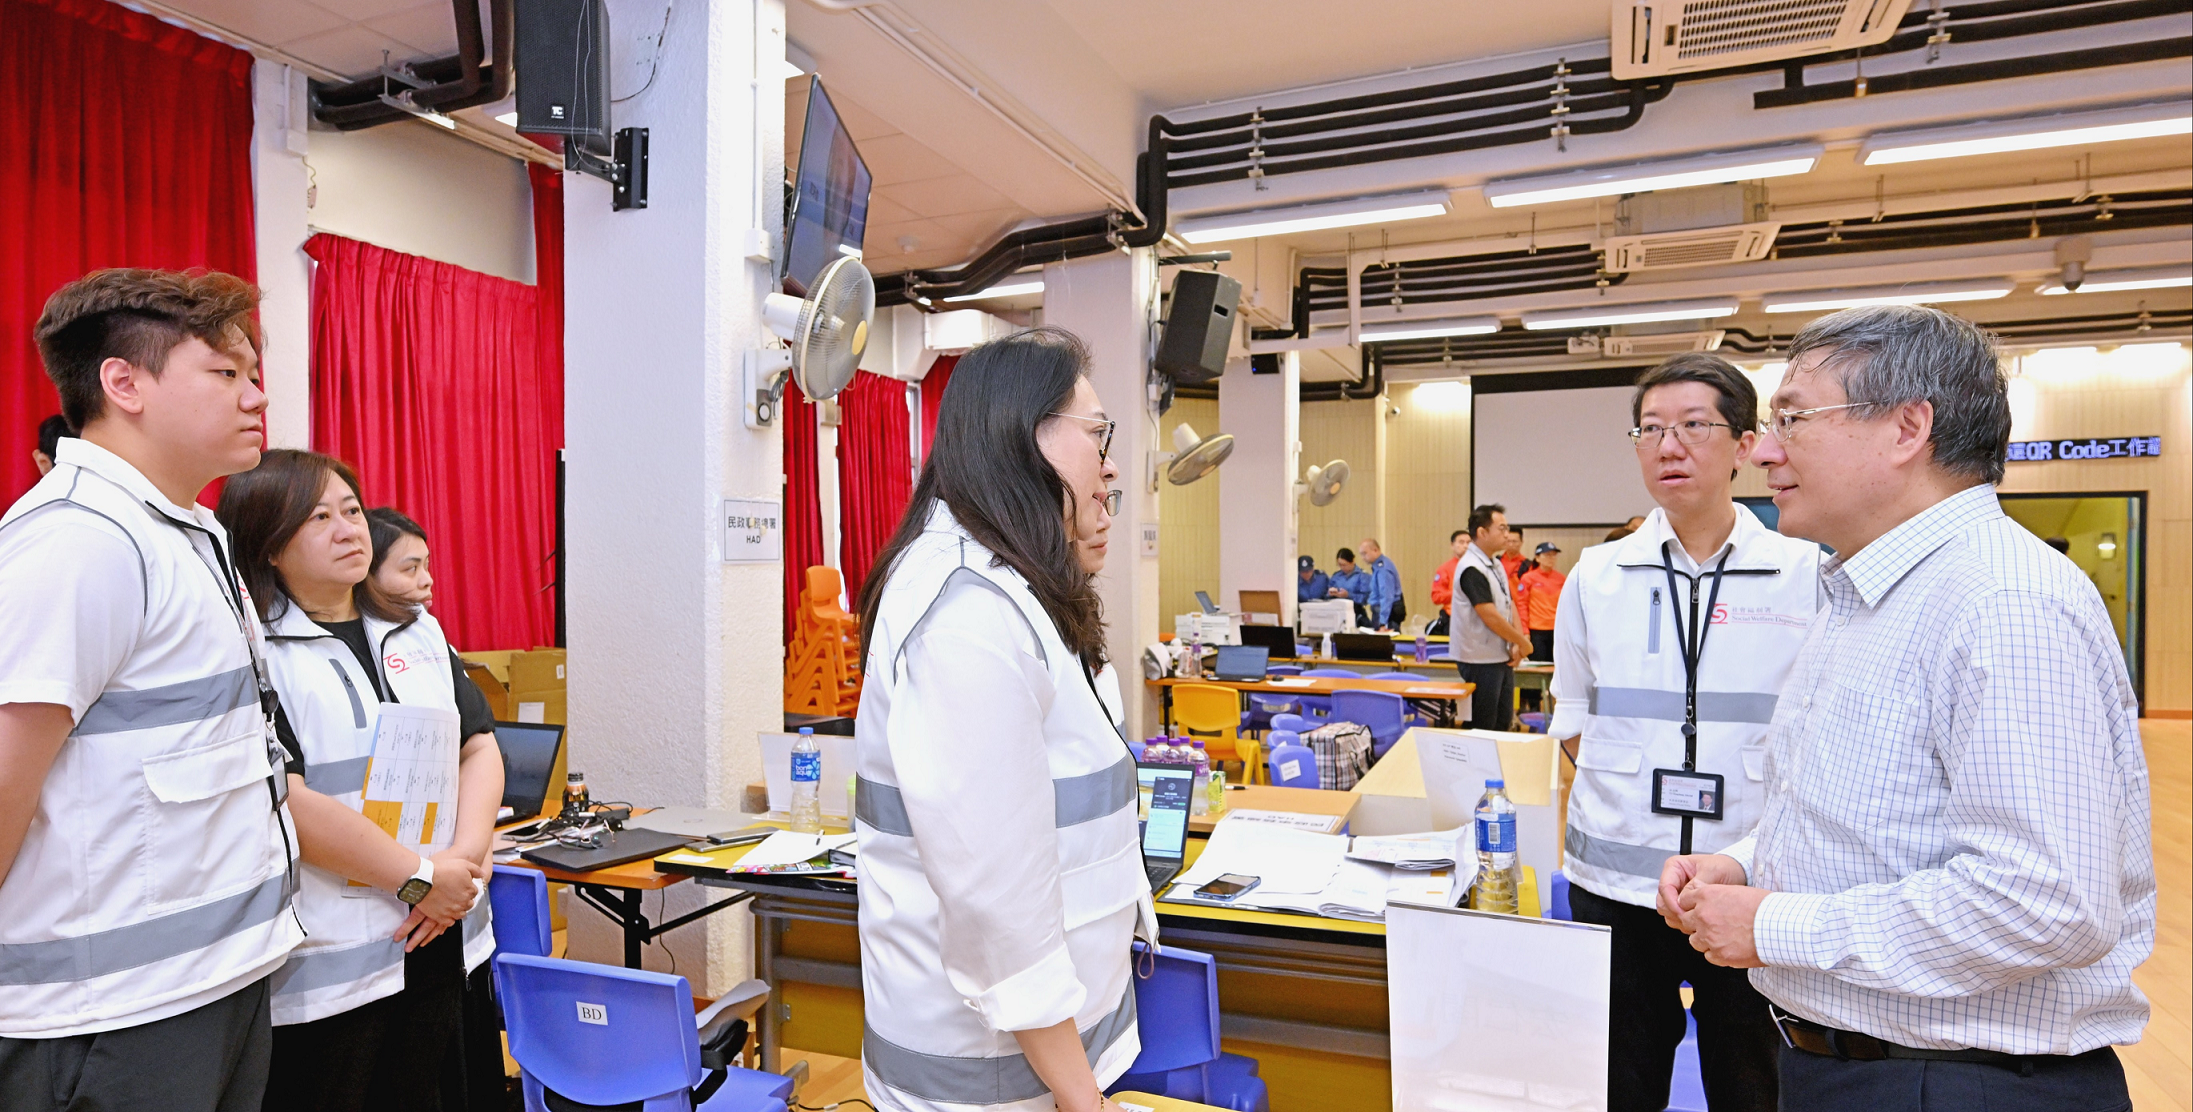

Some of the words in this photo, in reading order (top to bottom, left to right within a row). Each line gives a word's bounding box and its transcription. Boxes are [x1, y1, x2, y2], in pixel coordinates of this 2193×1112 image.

[746, 535, 761, 544] HAD
[1775, 616, 1807, 627] Department
[582, 1007, 602, 1021] BD
